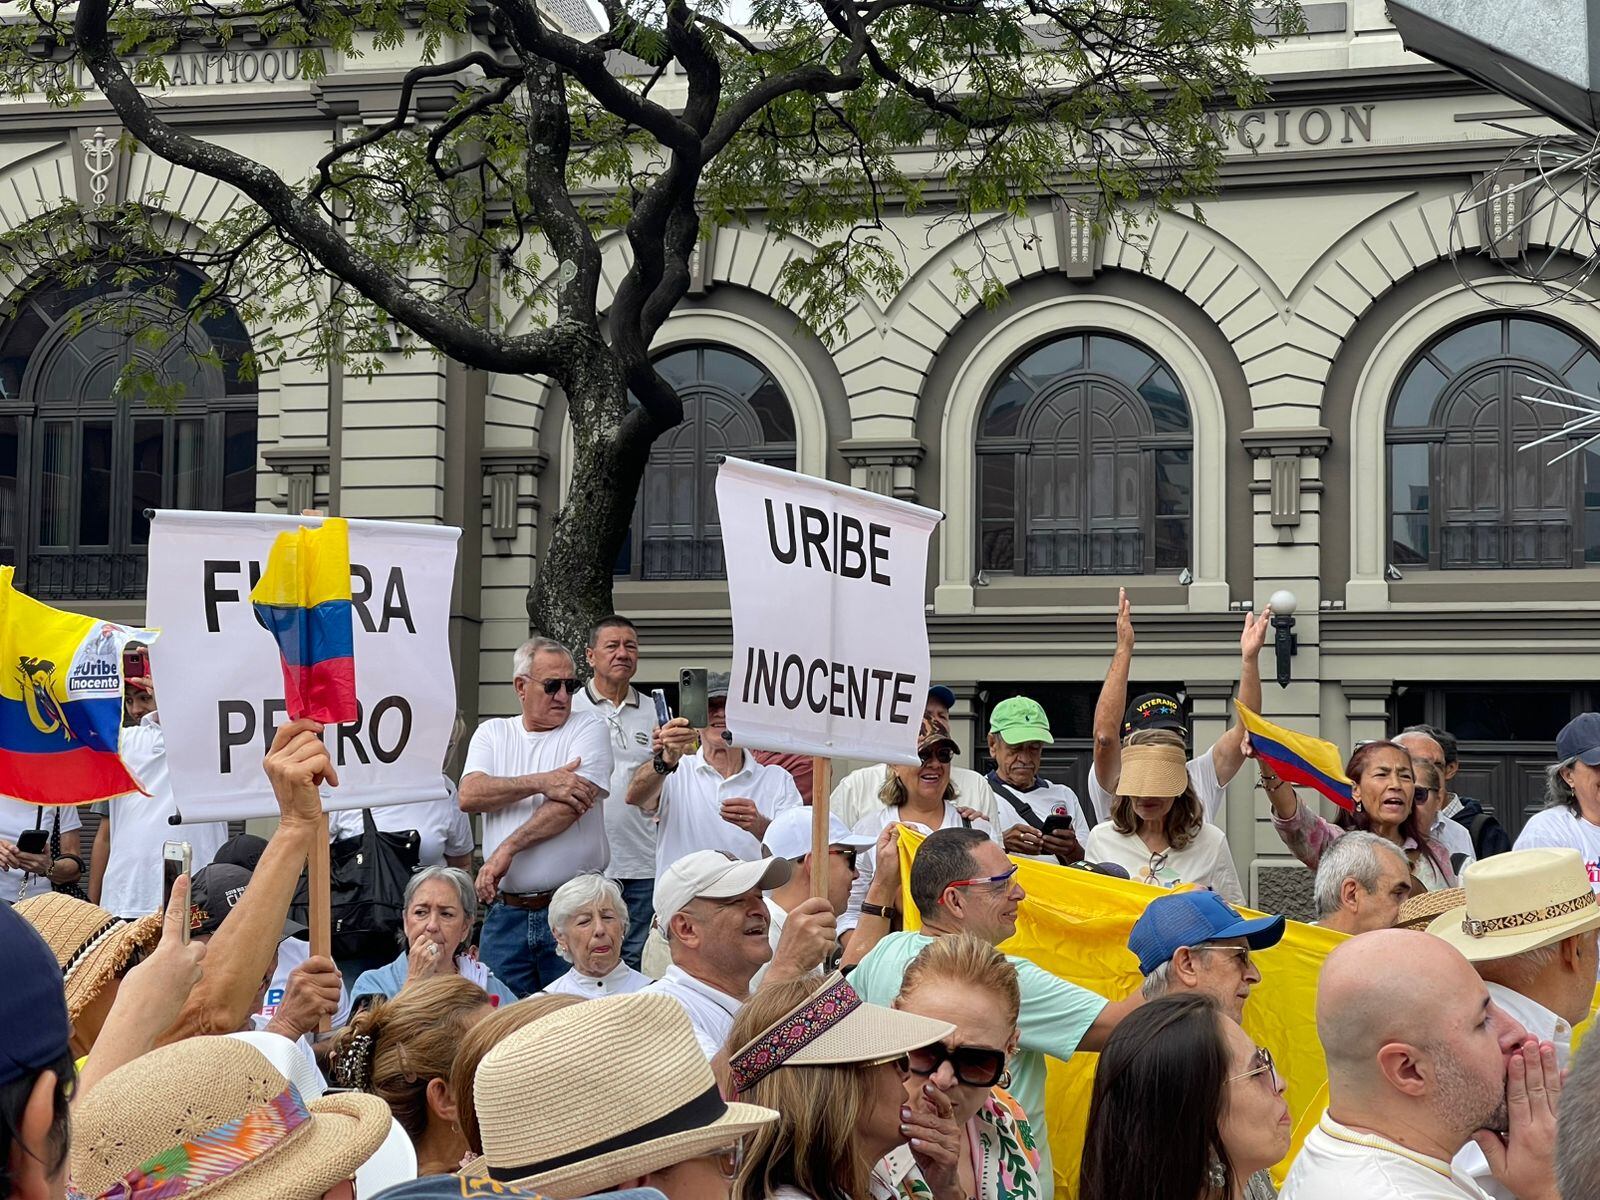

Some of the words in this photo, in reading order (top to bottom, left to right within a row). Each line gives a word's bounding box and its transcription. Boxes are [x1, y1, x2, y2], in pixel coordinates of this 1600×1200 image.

[170, 48, 327, 86] ANTIOQU
[764, 498, 891, 586] URIBE
[203, 560, 417, 634] FRA
[71, 678, 118, 689] Inocente
[73, 660, 117, 676] #Uribe
[742, 647, 916, 724] INOCENTE
[1136, 698, 1178, 712] VETERANO
